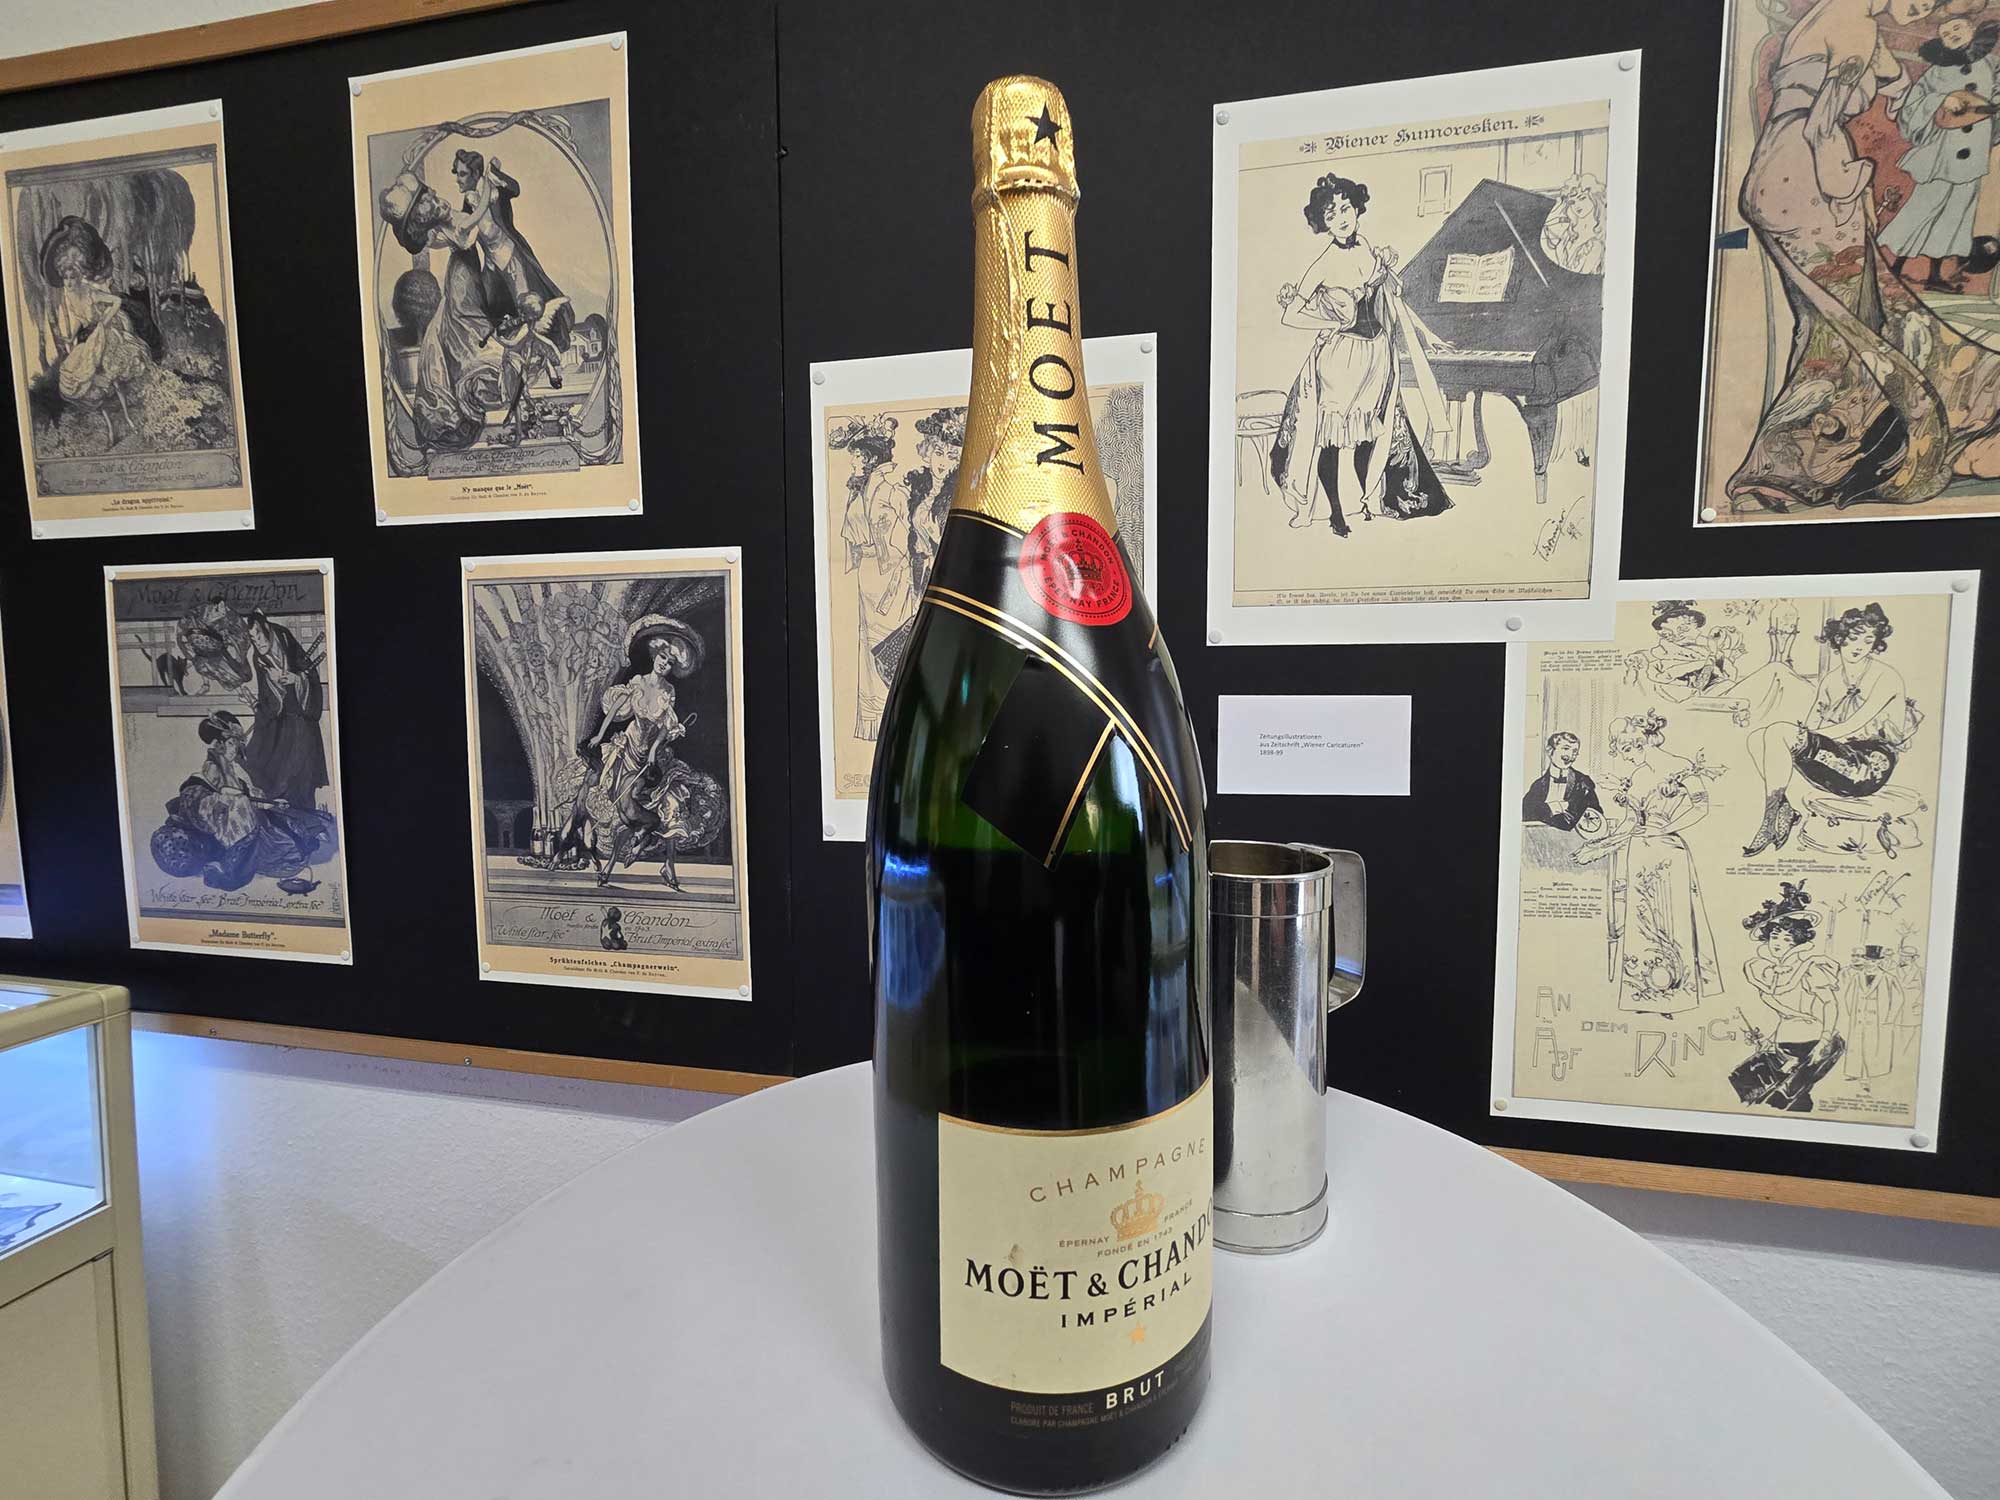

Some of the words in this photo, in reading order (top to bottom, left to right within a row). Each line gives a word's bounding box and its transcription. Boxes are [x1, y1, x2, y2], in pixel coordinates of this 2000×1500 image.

[1324, 134, 1388, 154] Wiener
[1096, 578, 1120, 608] FRANCE
[1581, 1021, 1628, 1034] DEM
[1029, 1138, 1206, 1203] CHAMPAGNE
[1059, 1235, 1110, 1249] ÉPERNAY
[1163, 1198, 1193, 1223] FRANCE
[1137, 1239, 1150, 1248] EN
[964, 1258, 1078, 1300] MOËT
[1087, 1273, 1109, 1297] &
[1061, 1272, 1192, 1328] IMPÉRIAL
[1106, 1370, 1165, 1410] BRUT
[1048, 1405, 1060, 1417] DE
[1062, 1402, 1095, 1416] FRANCE
